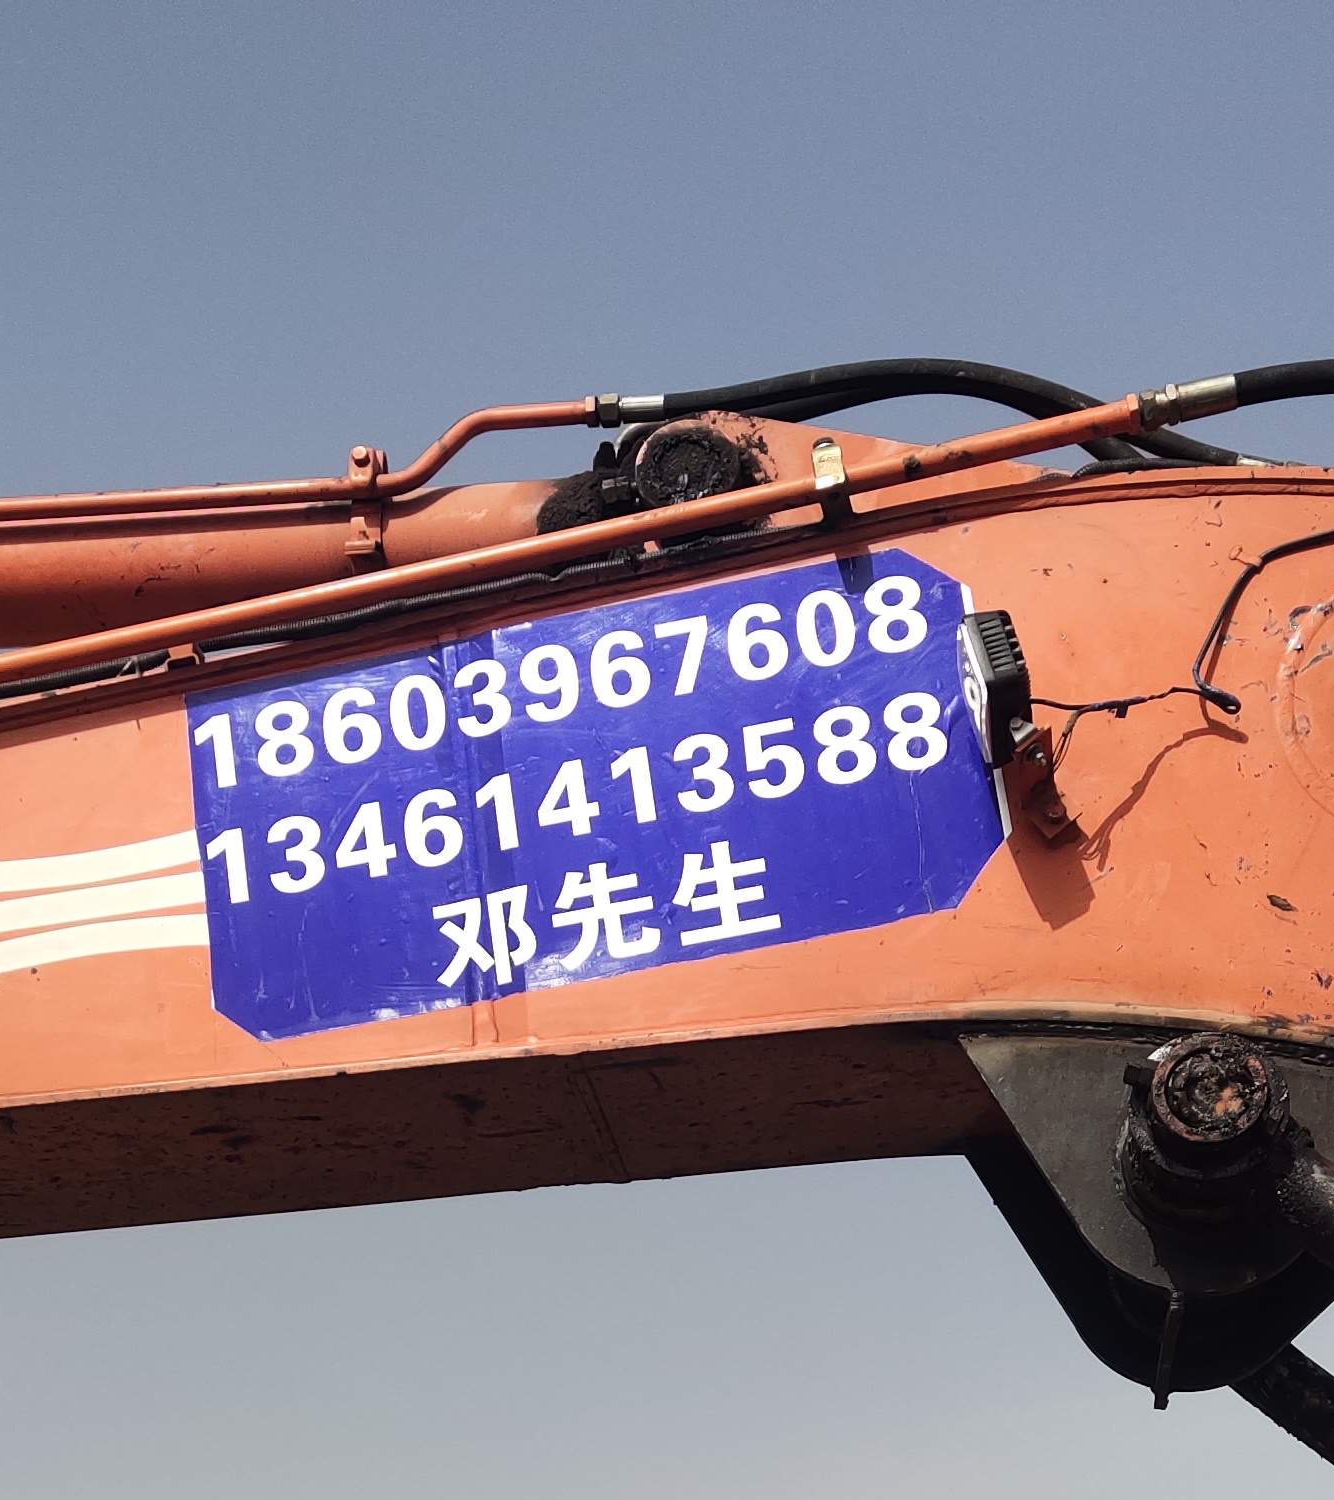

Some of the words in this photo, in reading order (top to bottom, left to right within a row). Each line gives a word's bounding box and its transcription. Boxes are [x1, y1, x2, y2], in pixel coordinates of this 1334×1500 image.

[194, 575, 929, 788] 18603967608
[205, 692, 949, 904] 13461413588
[433, 839, 782, 991] 邓先生
